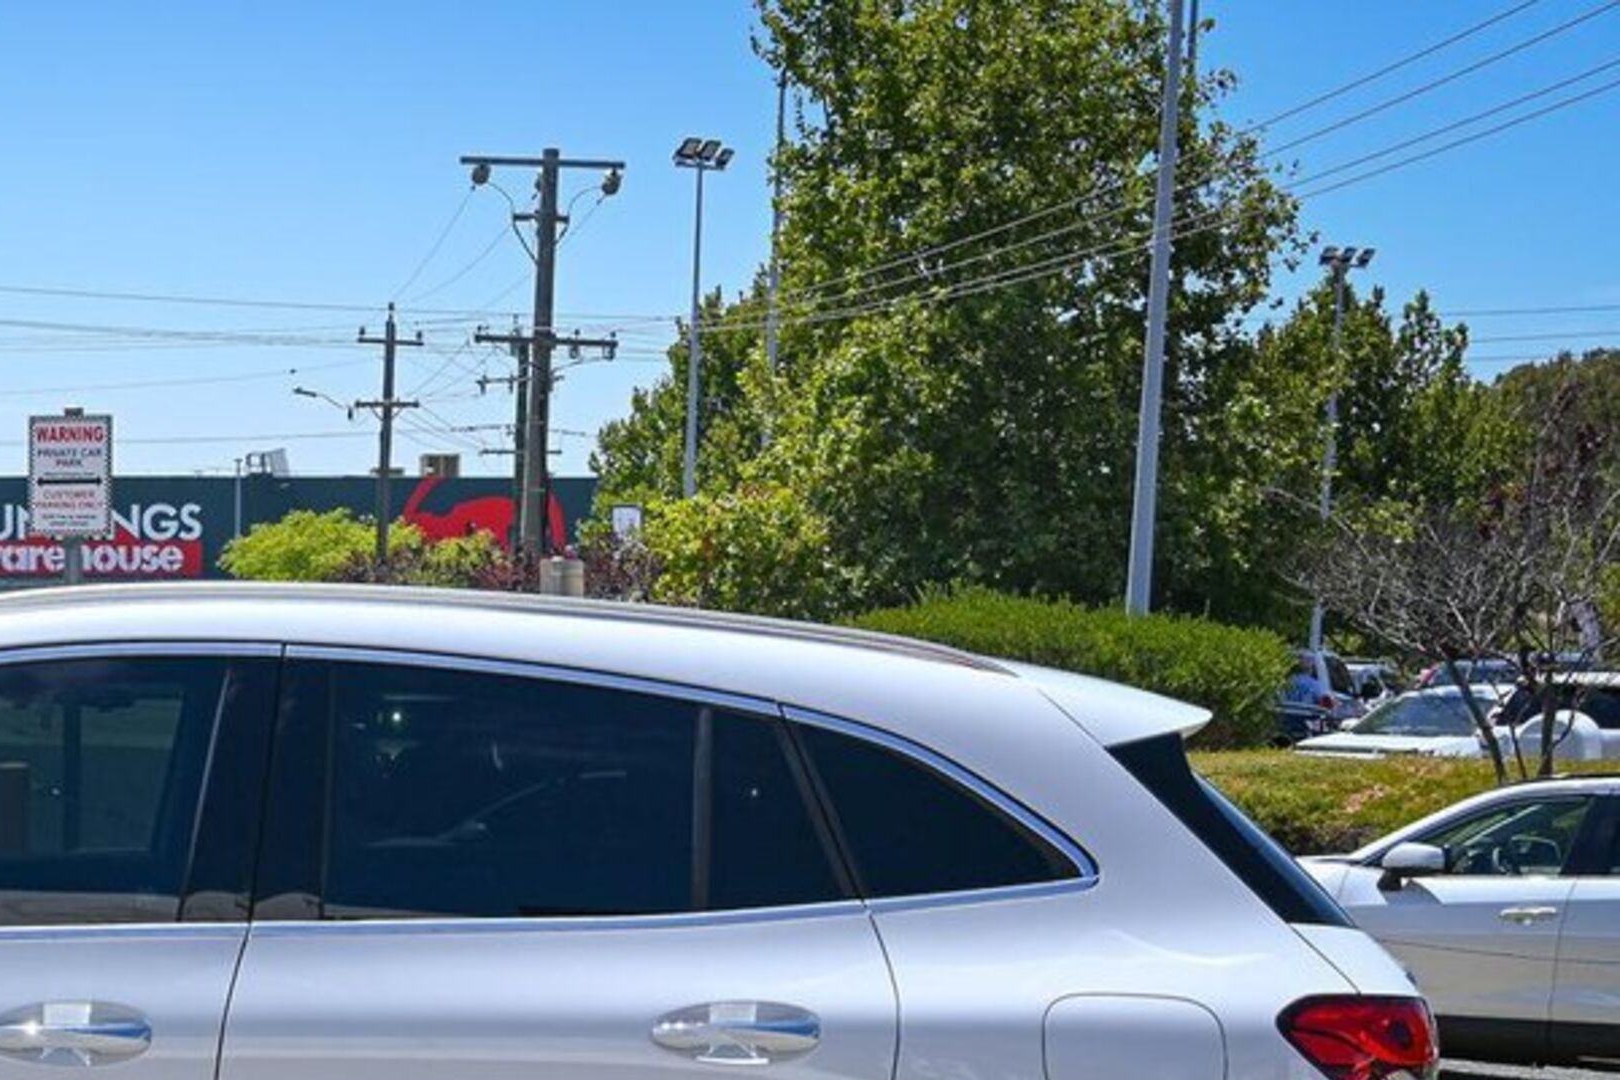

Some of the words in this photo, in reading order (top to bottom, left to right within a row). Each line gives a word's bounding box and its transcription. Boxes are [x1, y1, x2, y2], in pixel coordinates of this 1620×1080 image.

[36, 426, 104, 442] WARNING
[37, 448, 77, 457] PRIVATE
[80, 448, 102, 457] CAR
[55, 458, 82, 467] PARK
